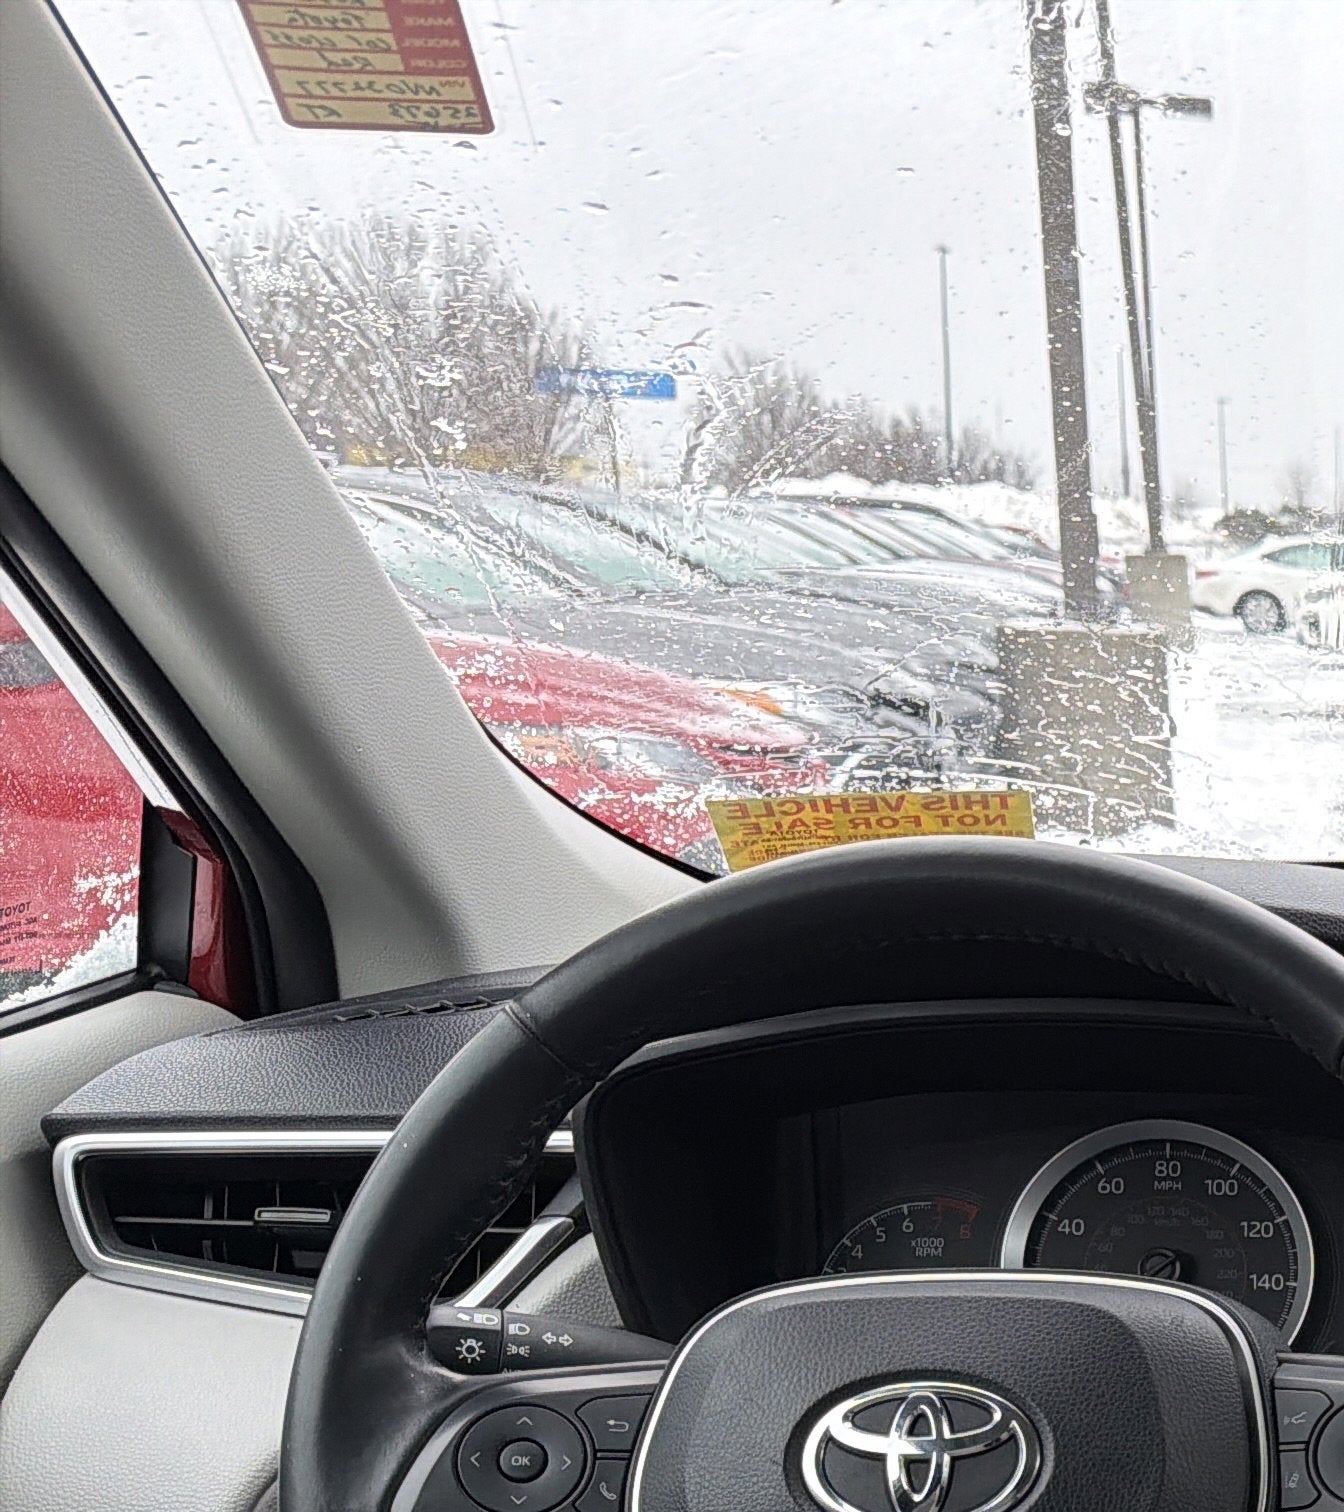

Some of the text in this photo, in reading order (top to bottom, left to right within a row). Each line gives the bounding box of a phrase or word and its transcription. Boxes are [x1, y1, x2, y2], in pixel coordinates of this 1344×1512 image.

[1154, 1161, 1181, 1178] 80
[1098, 1178, 1124, 1195] 60
[1154, 1180, 1182, 1192] MPH
[1205, 1179, 1238, 1196] 100
[902, 1218, 914, 1232] 6
[960, 1224, 970, 1239] 8
[1058, 1220, 1085, 1236] 40
[1240, 1221, 1274, 1238] 120
[876, 1227, 886, 1242] 5
[911, 1238, 944, 1247] x1000
[851, 1245, 863, 1259] 4
[916, 1248, 942, 1257] RPM
[1250, 1274, 1284, 1291] 140
[512, 1455, 531, 1466] OK
